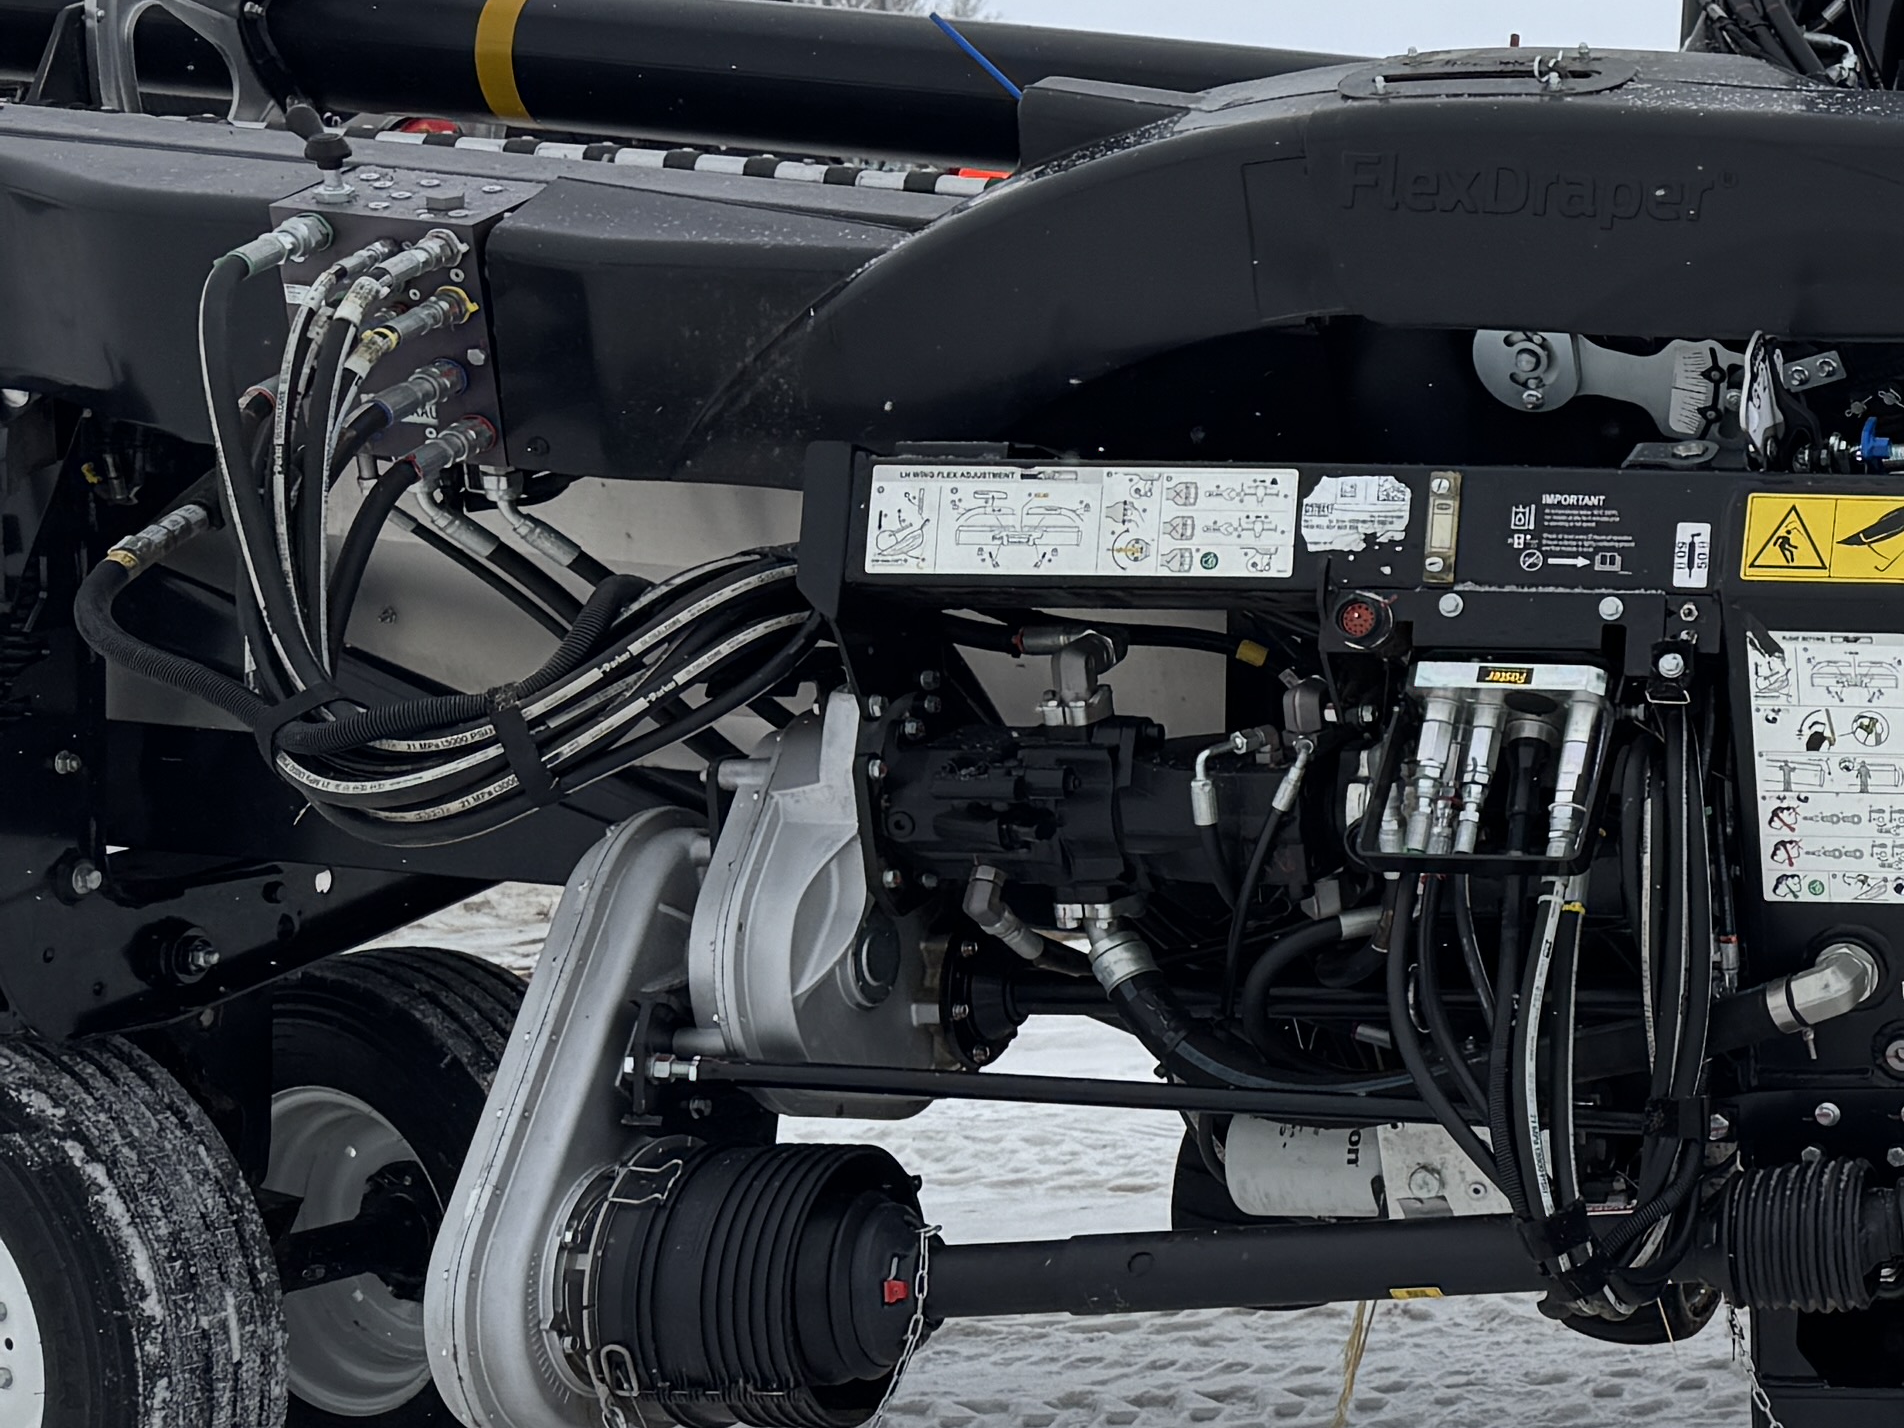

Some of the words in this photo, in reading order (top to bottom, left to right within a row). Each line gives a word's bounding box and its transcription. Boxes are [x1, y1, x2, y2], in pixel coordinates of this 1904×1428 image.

[960, 471, 1015, 479] ADJUSTMENT
[1542, 494, 1606, 506] IMPORTANT
[648, 681, 677, 702] Parker
[459, 798, 470, 808] 21
[471, 788, 494, 802] MPa
